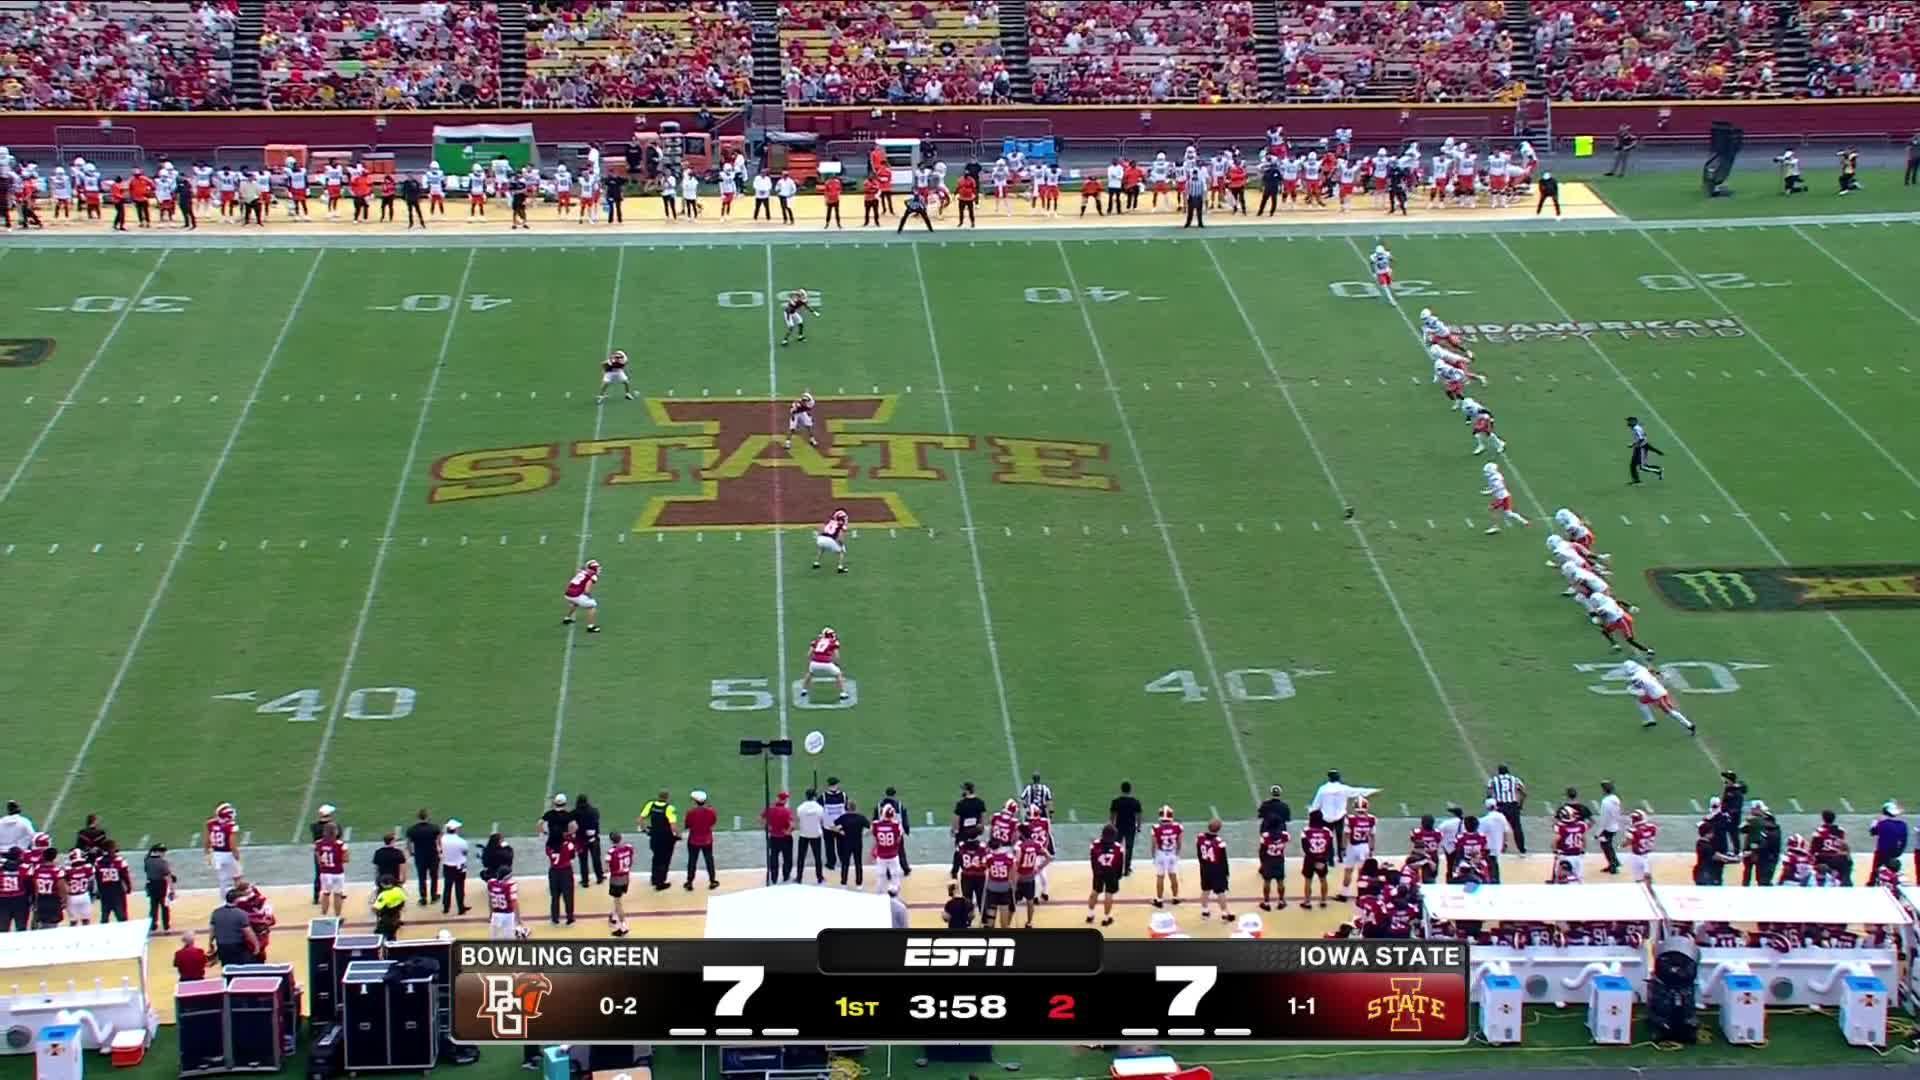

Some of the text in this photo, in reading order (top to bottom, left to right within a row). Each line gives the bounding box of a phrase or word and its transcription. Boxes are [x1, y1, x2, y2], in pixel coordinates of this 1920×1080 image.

[402, 294, 512, 312] 40
[1023, 286, 1130, 303] 40
[427, 431, 1121, 503] STATE
[1145, 667, 1297, 702] 40
[709, 677, 859, 712] 50
[256, 686, 417, 722] 40
[878, 833, 895, 846] 98
[320, 851, 336, 867] 41
[551, 853, 561, 865] 7
